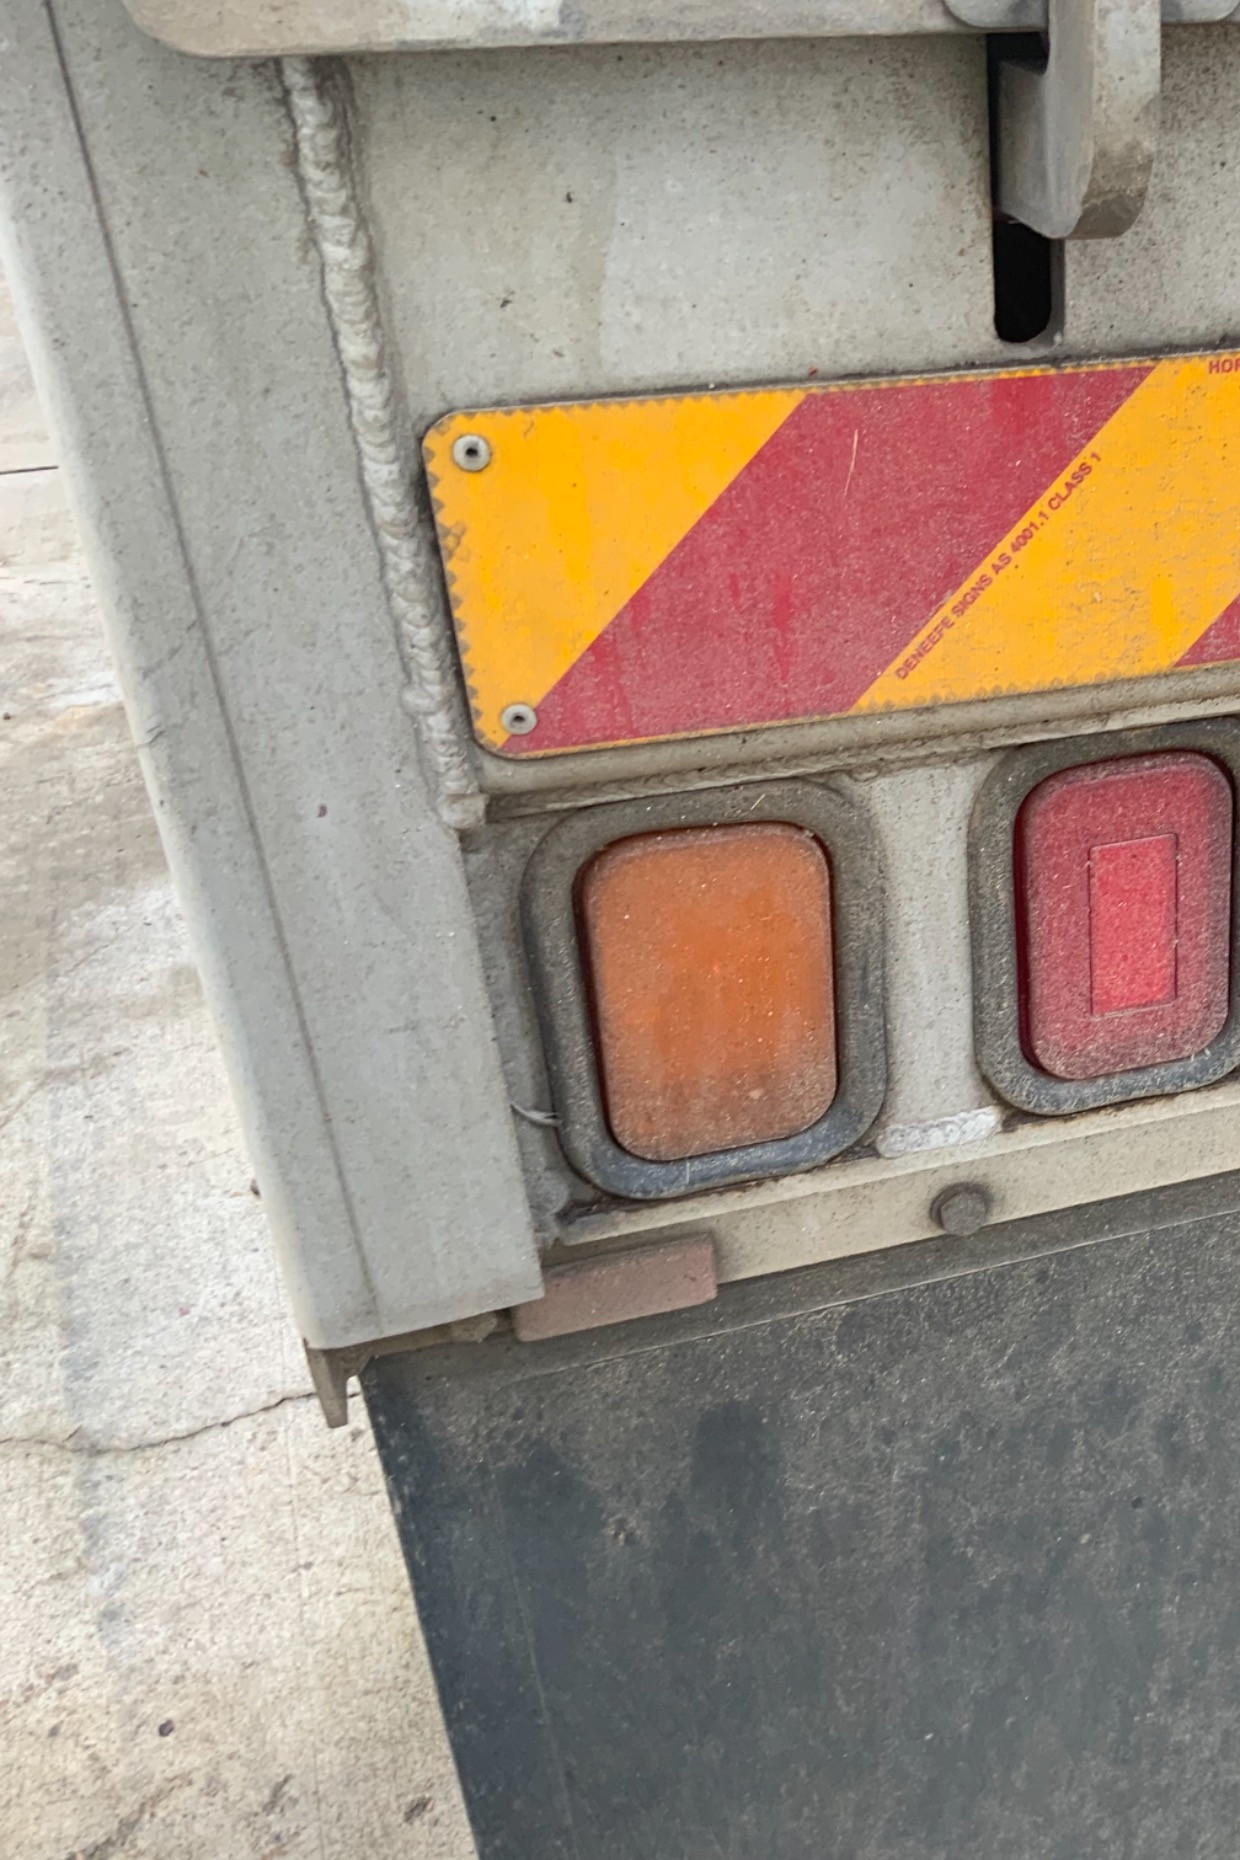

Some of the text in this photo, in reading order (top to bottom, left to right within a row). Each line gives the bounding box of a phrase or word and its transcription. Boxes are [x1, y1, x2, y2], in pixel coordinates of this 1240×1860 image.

[951, 574, 993, 617] SIGNS
[991, 553, 1012, 575] AS
[1010, 511, 1049, 552] 4001.1
[1047, 462, 1092, 511] CLASS
